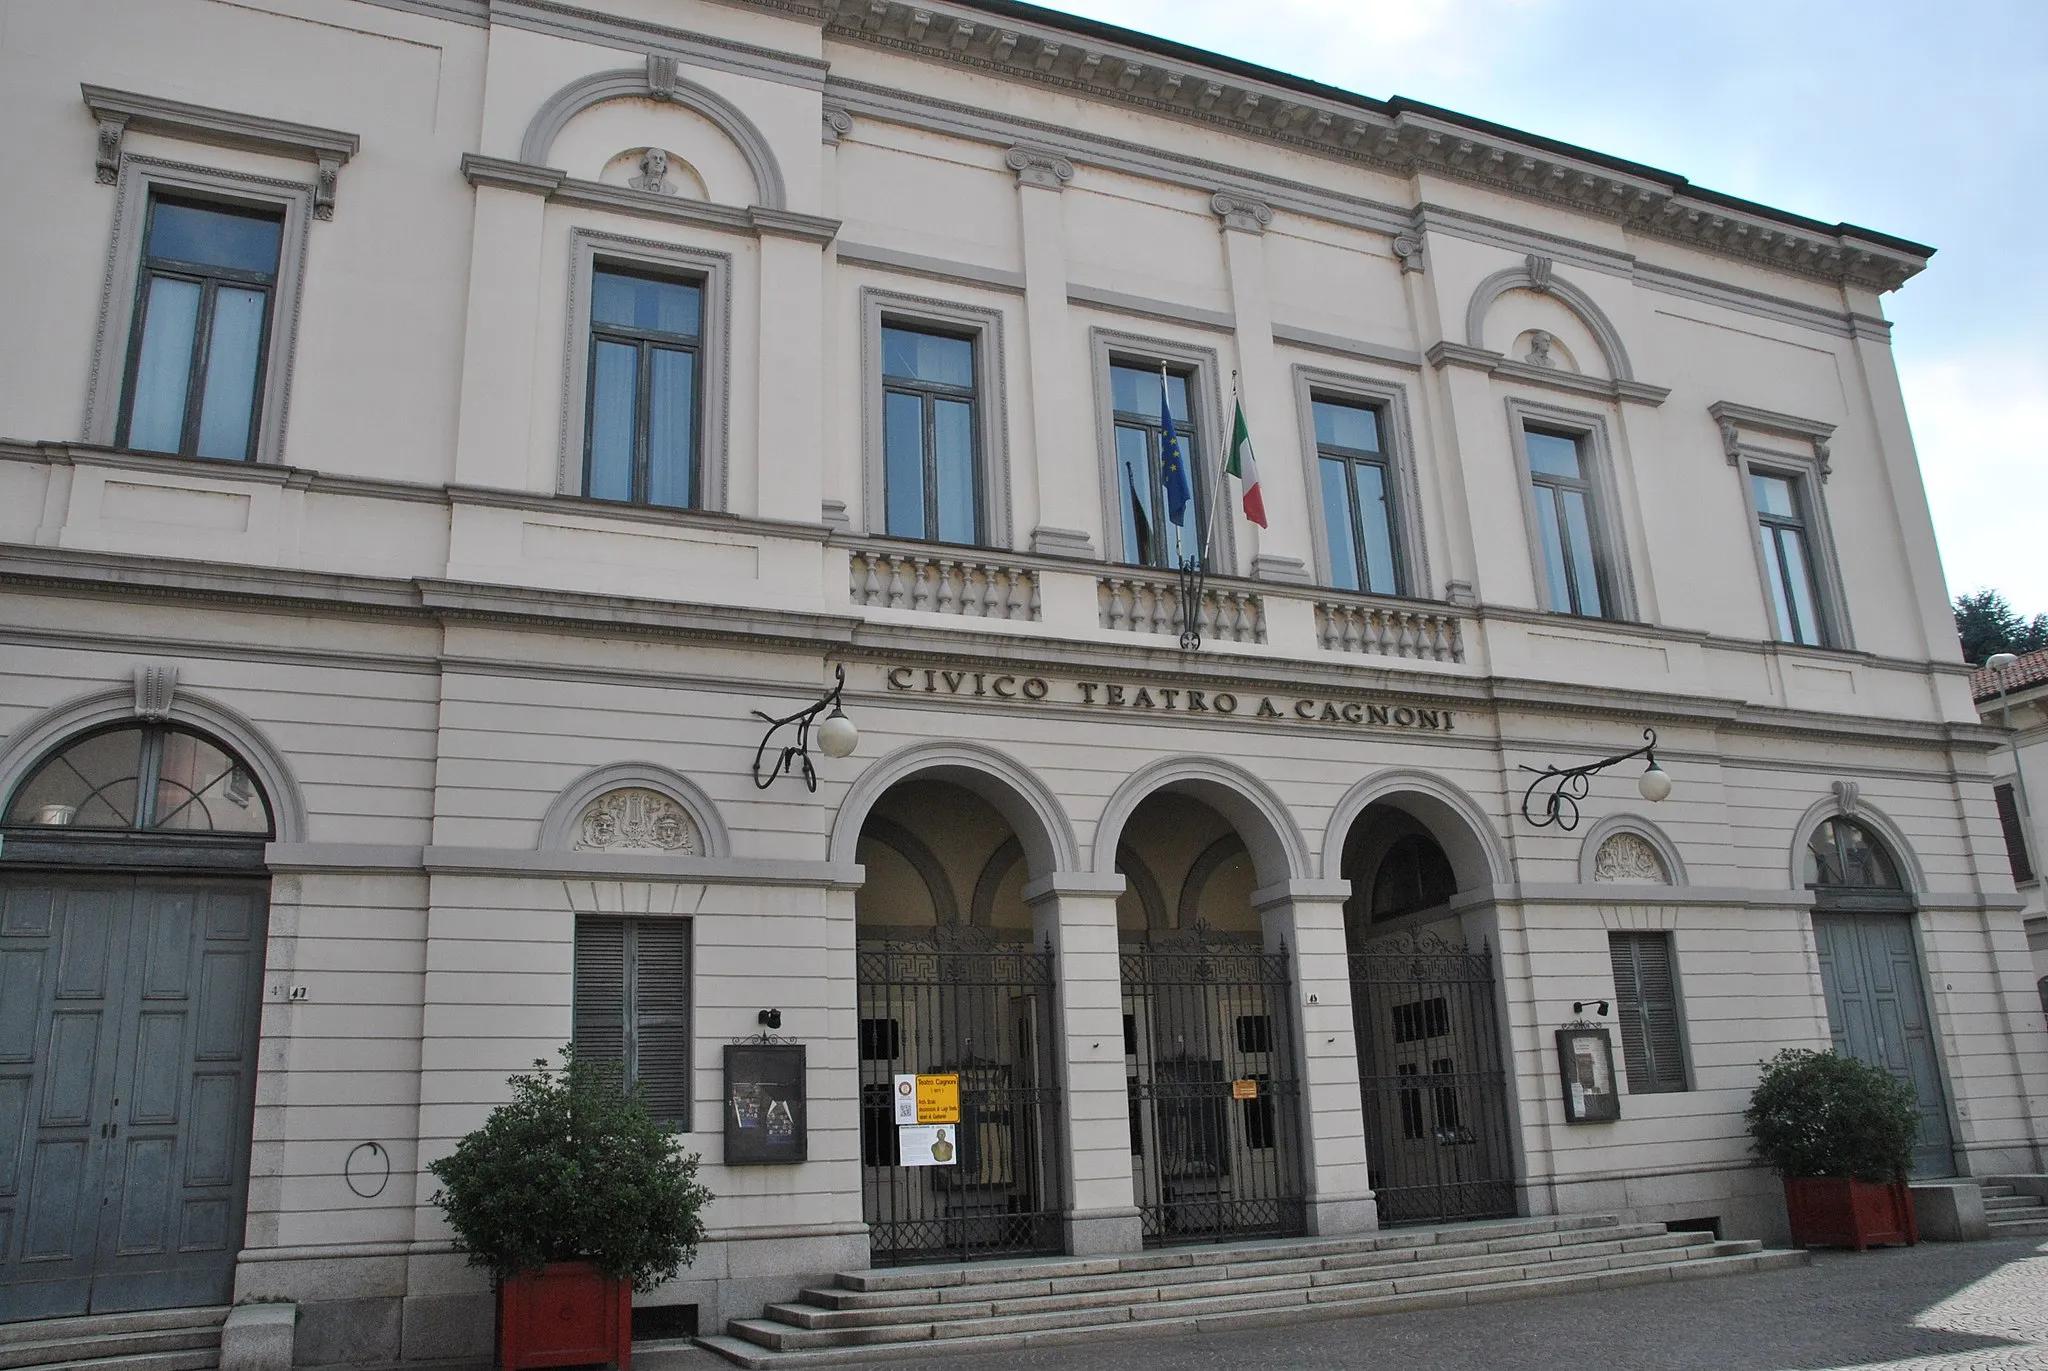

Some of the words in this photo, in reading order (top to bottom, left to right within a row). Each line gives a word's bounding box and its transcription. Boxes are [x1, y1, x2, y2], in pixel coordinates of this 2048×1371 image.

[889, 667, 1049, 699] CIVICO
[1078, 682, 1238, 713] TEATRO
[1257, 696, 1284, 718] A.
[1294, 699, 1455, 730] CAGNONI
[292, 987, 307, 998] 47
[936, 1078, 957, 1087] Cagnoni
